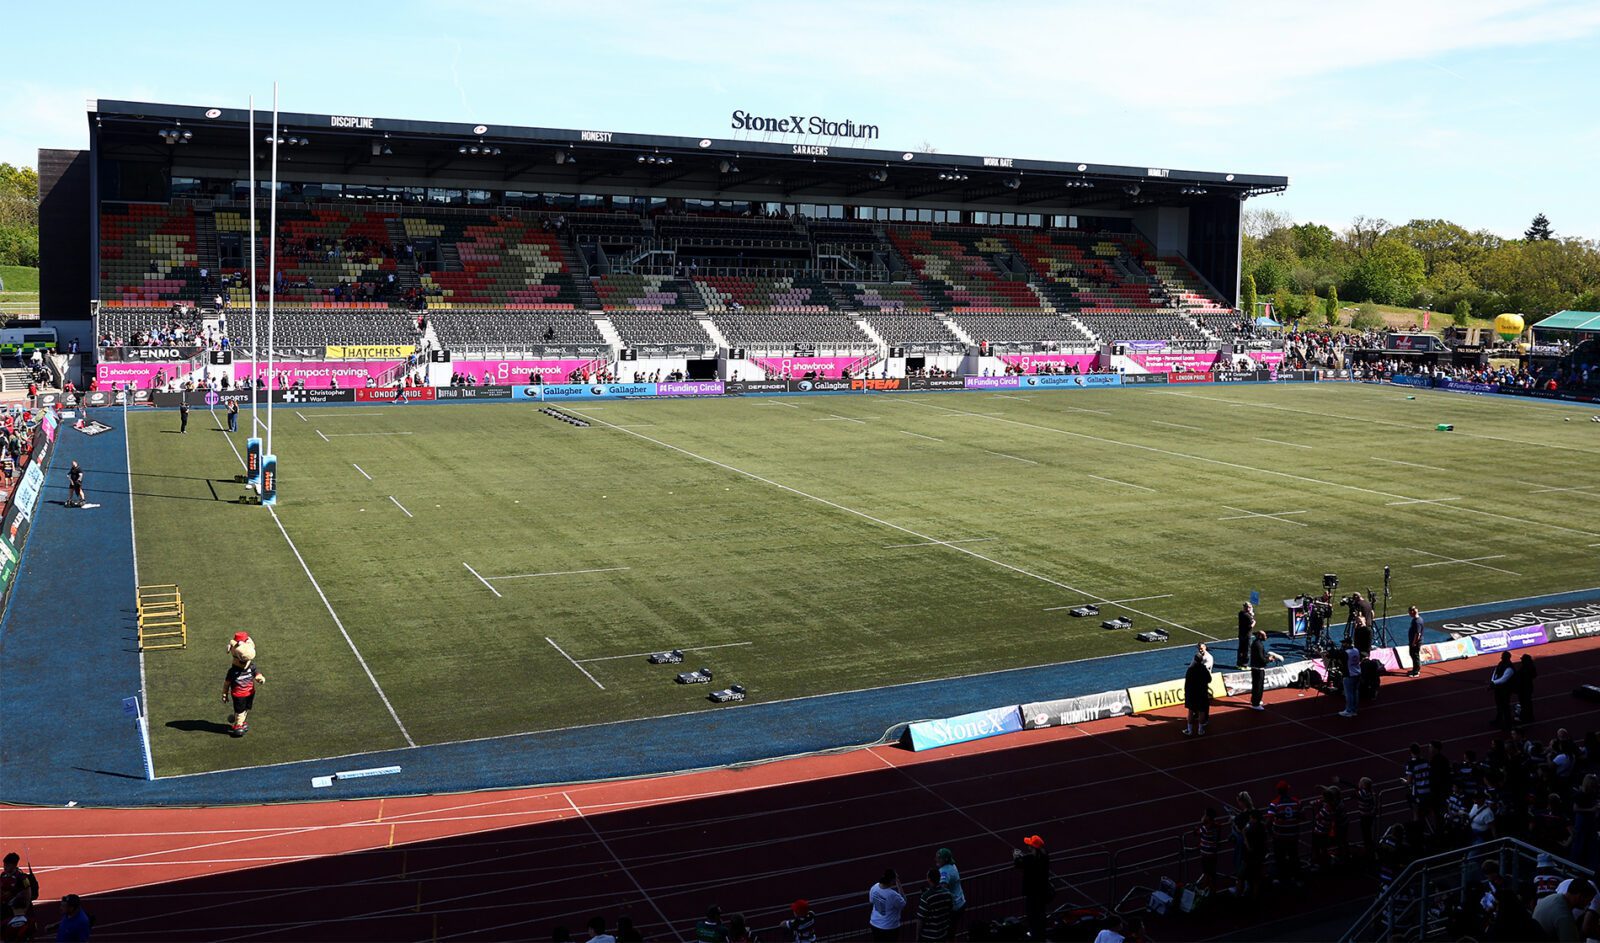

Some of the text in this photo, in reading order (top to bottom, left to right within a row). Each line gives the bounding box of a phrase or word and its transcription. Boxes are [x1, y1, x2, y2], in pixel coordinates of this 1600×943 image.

[331, 116, 373, 128] DISCIPLINE
[731, 109, 879, 139] StoneX Stadium
[581, 131, 613, 142] HONESTY
[792, 145, 829, 156] SARACENS
[983, 157, 1013, 168] WORK RATE
[1147, 168, 1170, 178] HUMILITY
[341, 347, 402, 358] THATCHERS
[511, 366, 562, 375] shawbrook
[793, 361, 835, 371] shawbrook
[294, 368, 330, 379] impact
[332, 368, 368, 379] savings
[814, 380, 850, 390] Gallagher
[974, 377, 1018, 387] Funding Circle
[309, 389, 346, 397] Christopher
[437, 389, 457, 398] BUFFALO
[462, 389, 477, 398] TRACE
[542, 388, 582, 397] Gallagher
[609, 386, 646, 395] Gallagher
[667, 383, 722, 395] Funding Circle
[1060, 707, 1100, 725] HUMILITY
[931, 709, 1004, 744] StoneX
